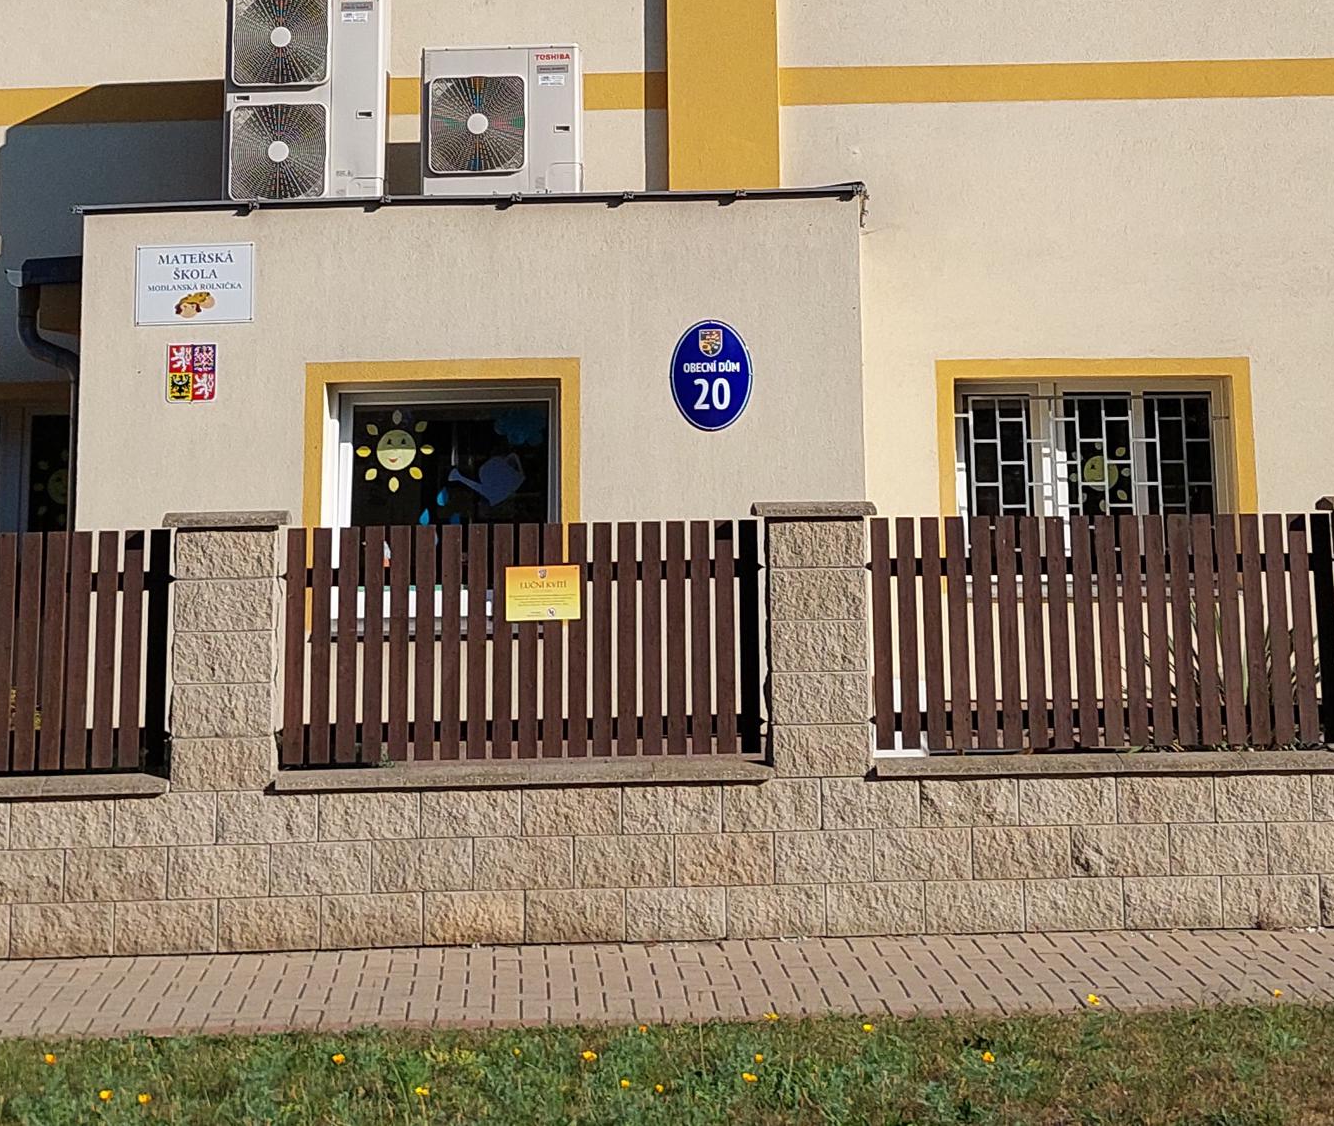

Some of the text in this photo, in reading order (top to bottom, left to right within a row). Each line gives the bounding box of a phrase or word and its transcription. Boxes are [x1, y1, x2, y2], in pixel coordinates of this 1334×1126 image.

[535, 53, 571, 61] TOSHIBA
[158, 250, 234, 265] MATEŘSKÁ
[173, 267, 217, 280] ŠKOLA
[200, 281, 242, 290] ROLNIČKA
[683, 359, 740, 373] OBECNÍ DŮM
[693, 377, 731, 410] 20
